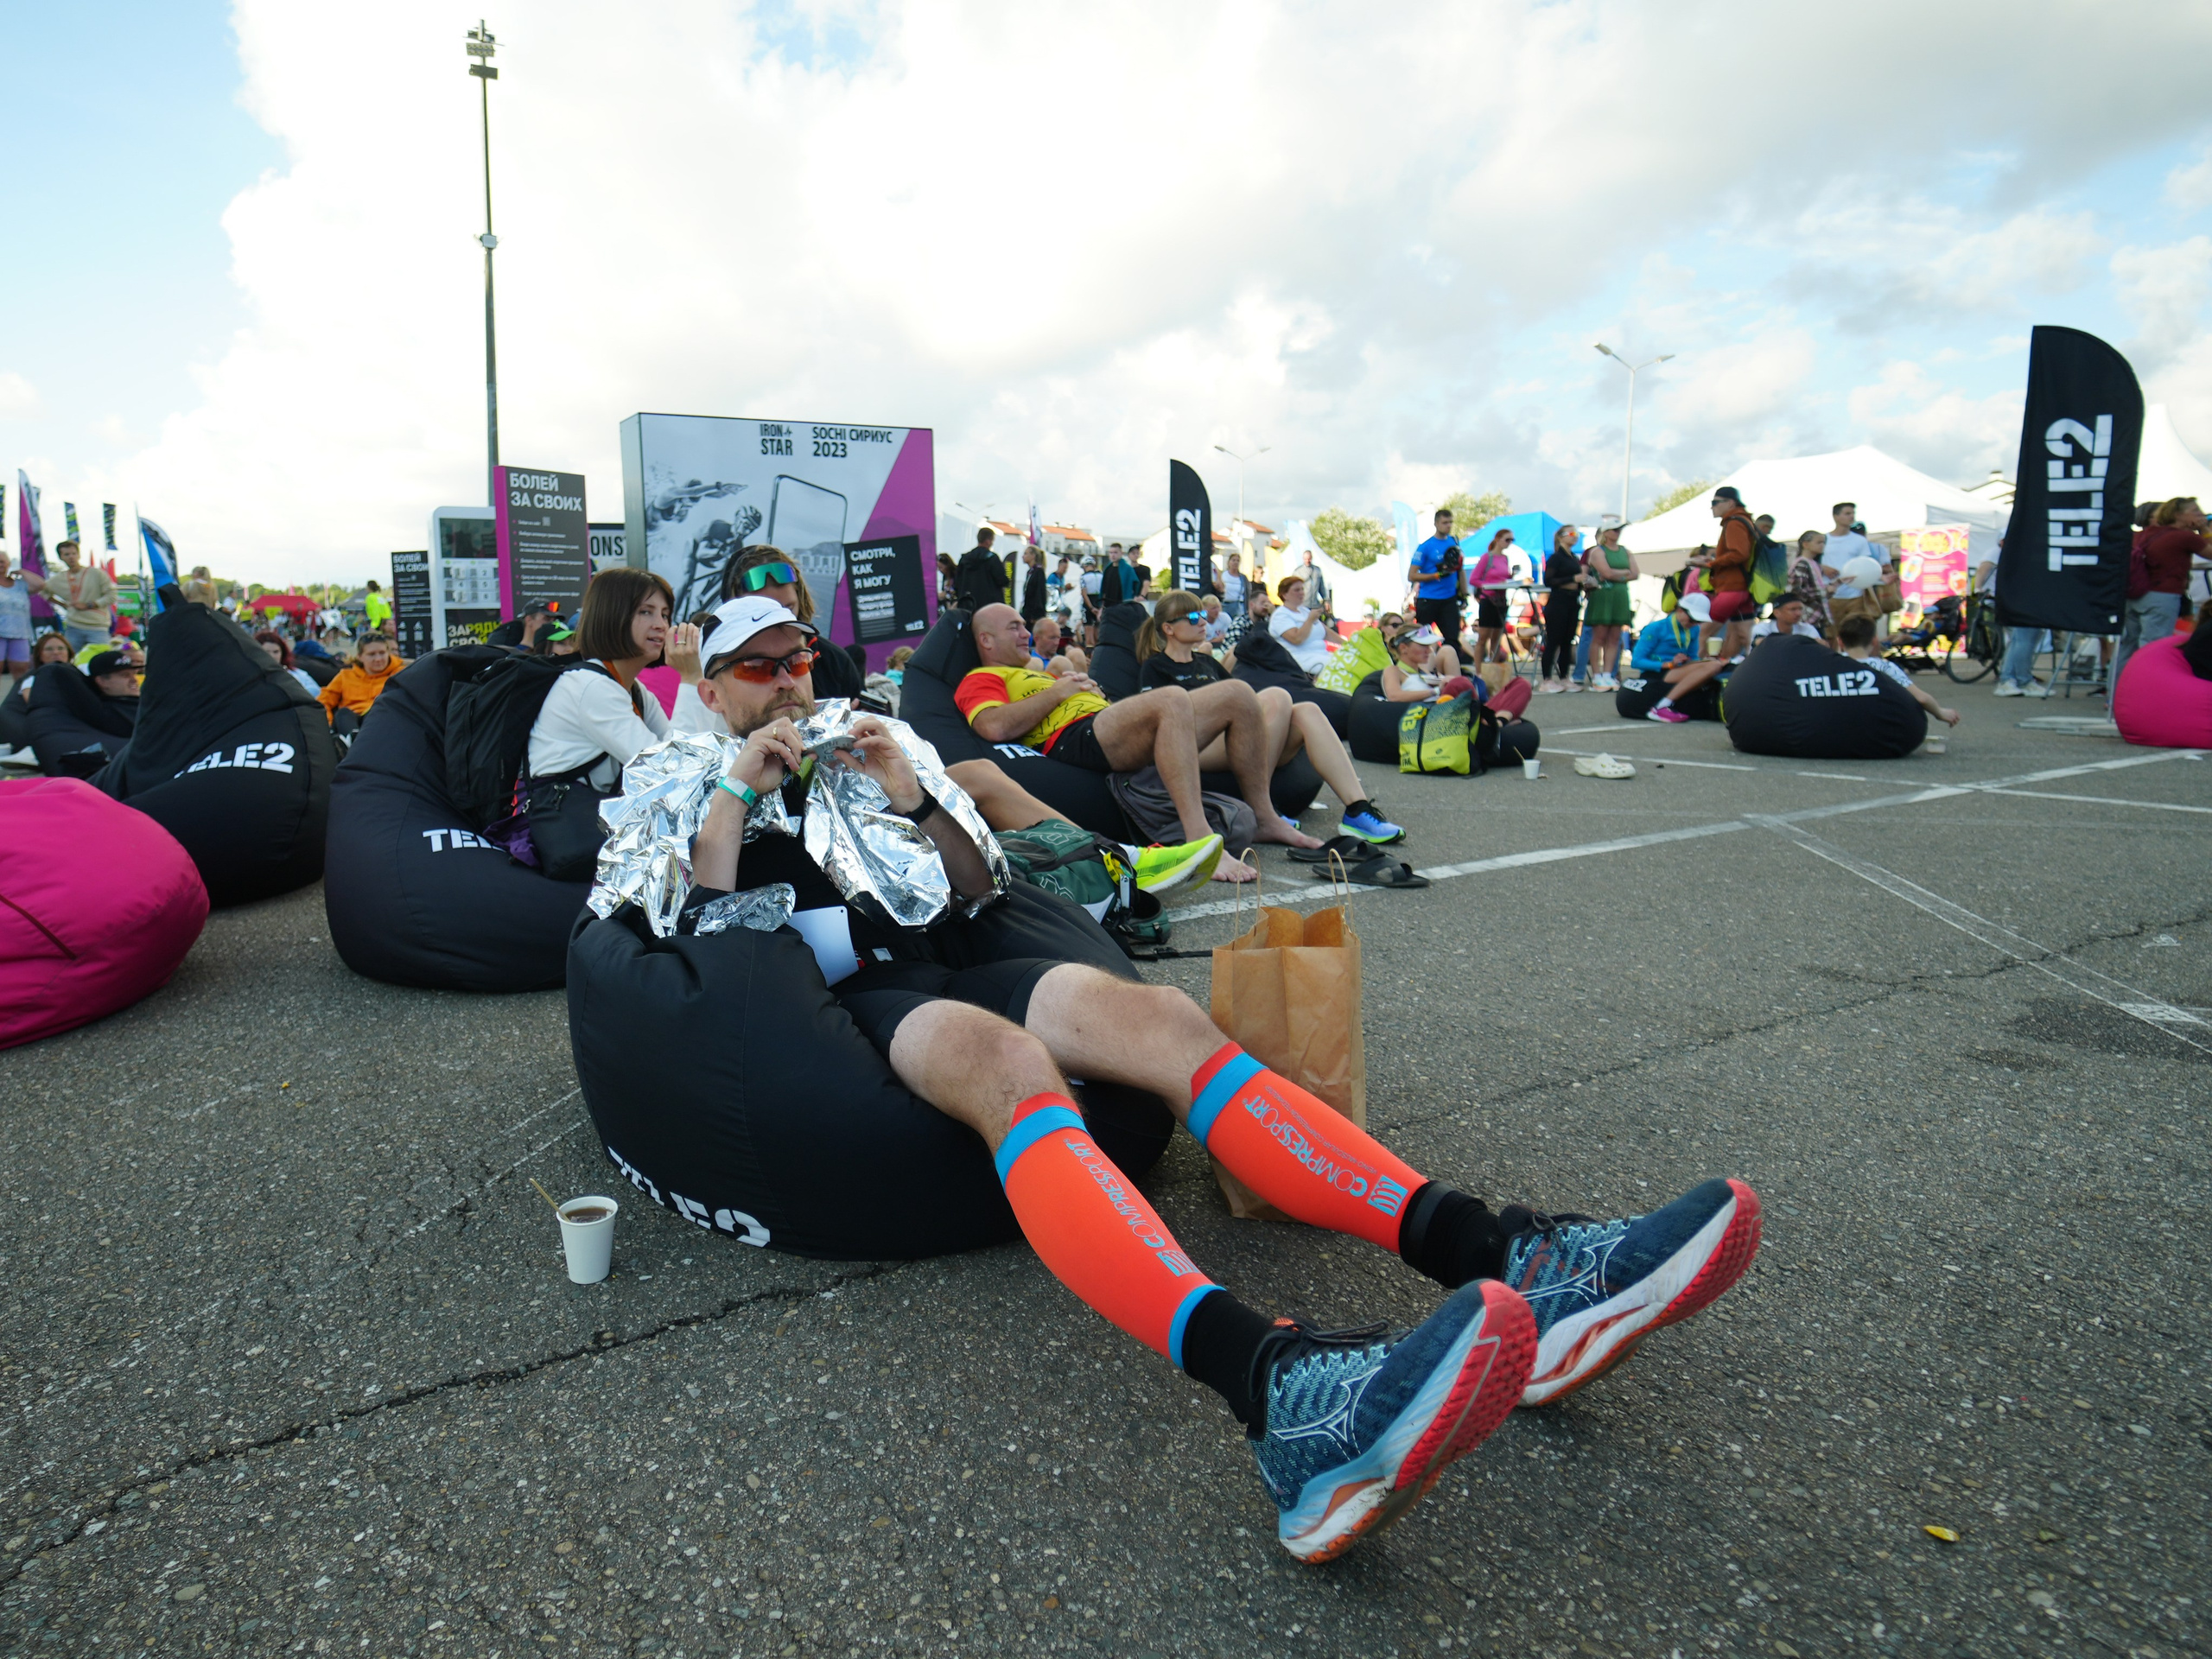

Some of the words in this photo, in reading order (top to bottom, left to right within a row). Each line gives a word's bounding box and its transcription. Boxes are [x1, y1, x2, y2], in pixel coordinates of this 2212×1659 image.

[760, 423, 783, 437] IRON
[812, 426, 846, 441] SOCHI
[849, 429, 893, 443] СИРИУС
[761, 438, 793, 455] STAR
[812, 441, 847, 458] 2023
[509, 472, 559, 492] БОЛЕЙ
[510, 491, 531, 508] ЗА
[533, 493, 583, 512] СВОИХ
[2044, 414, 2113, 572] TELE2
[590, 536, 626, 556] ONS
[849, 546, 895, 562] СМОТРИ,
[1175, 508, 1202, 592] TELE2
[851, 563, 874, 575] КАК
[853, 578, 862, 589] Я
[863, 575, 892, 588] МОГУ
[1795, 670, 1880, 697] TELE2
[174, 742, 296, 779] ELE2
